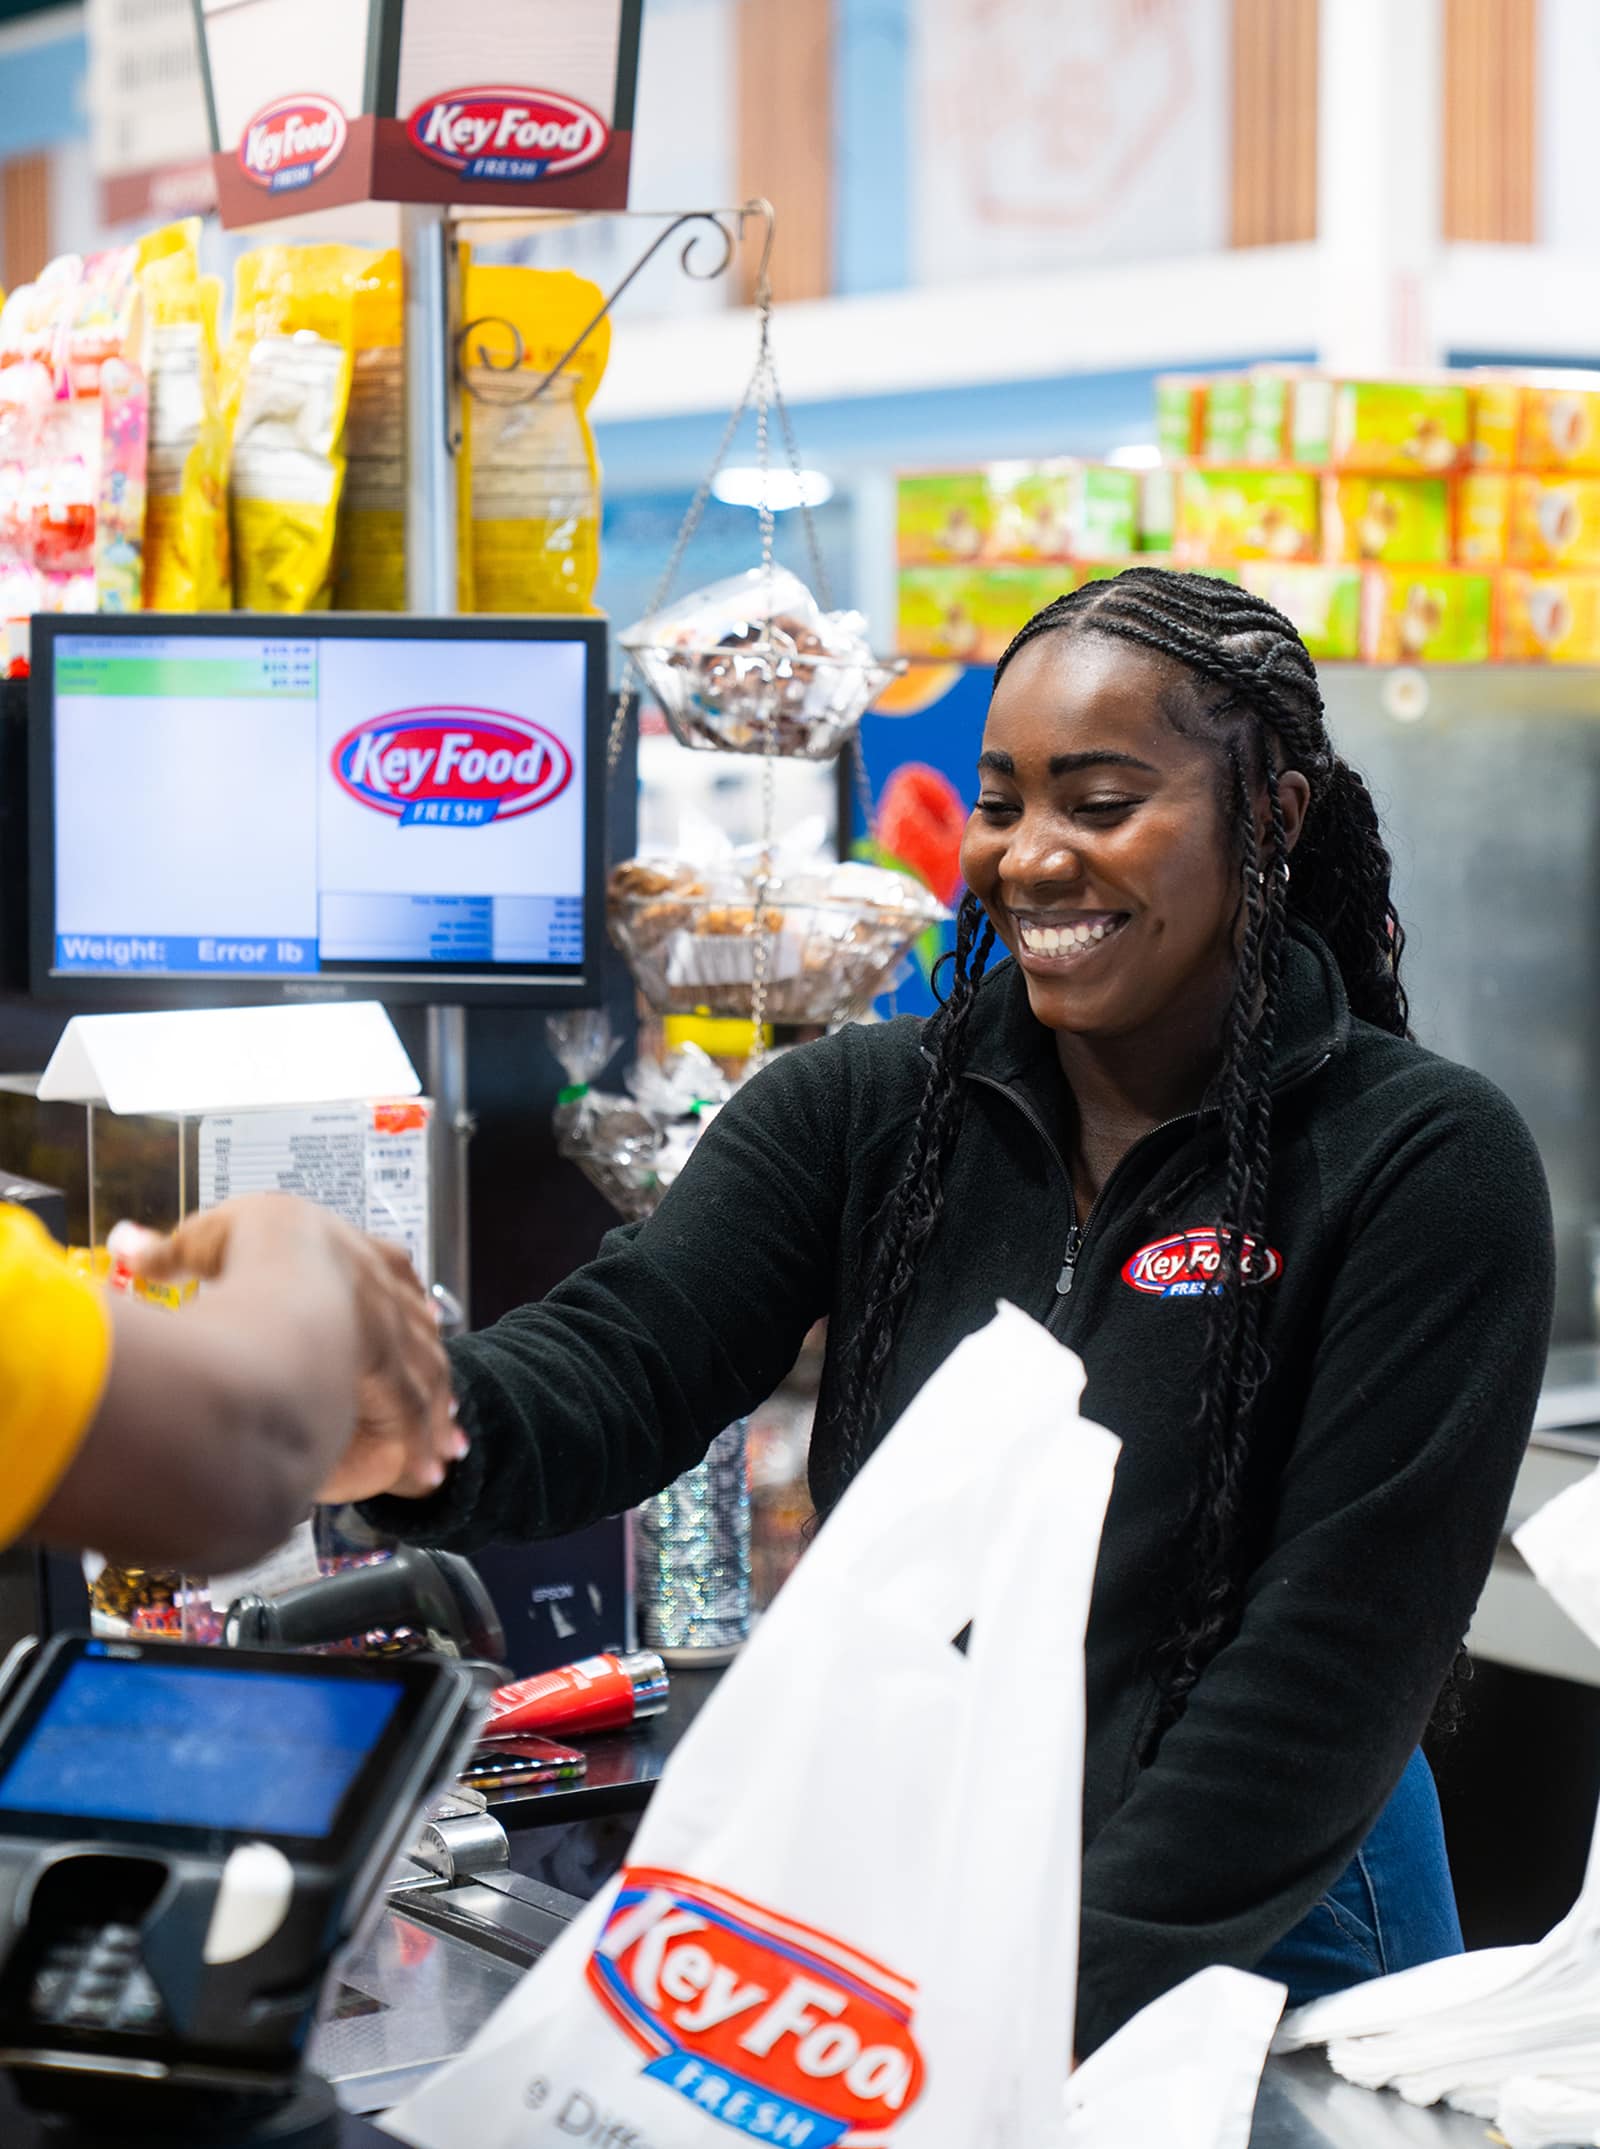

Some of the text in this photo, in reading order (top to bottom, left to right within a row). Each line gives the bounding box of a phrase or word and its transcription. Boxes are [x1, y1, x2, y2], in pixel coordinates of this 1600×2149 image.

[422, 104, 590, 154] Key Food
[472, 157, 538, 176] FRESH
[350, 732, 546, 795] Key Food
[412, 802, 484, 822] FRESH
[62, 936, 166, 965] Weight:
[197, 938, 268, 963] Error
[597, 1888, 769, 2032] Key
[672, 2059, 816, 2147] FRESH
